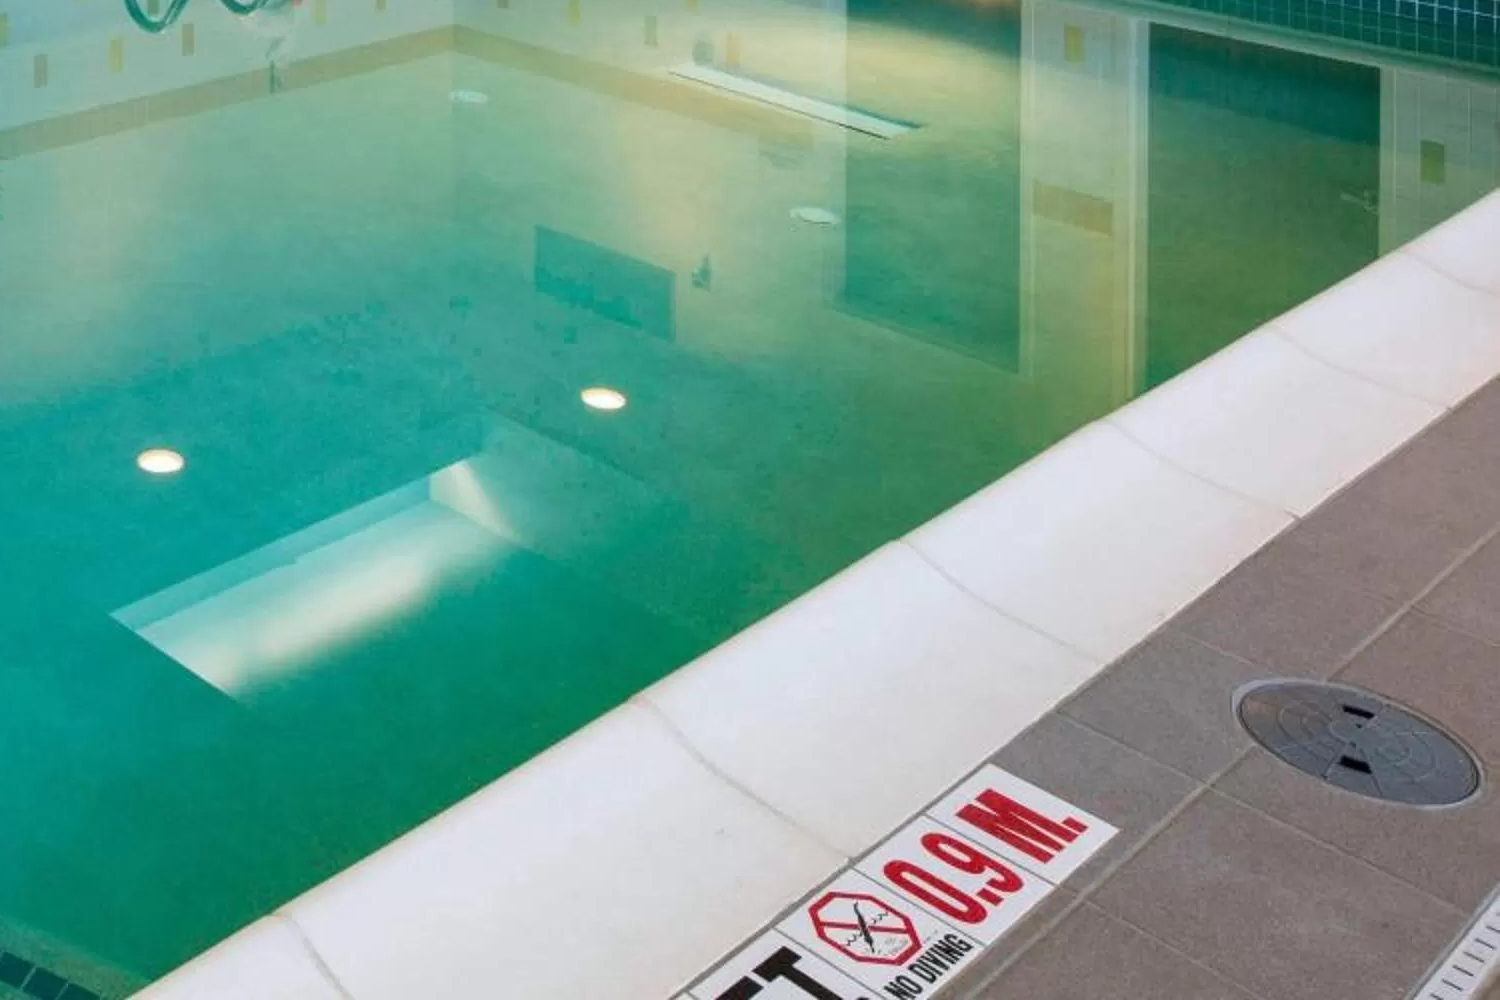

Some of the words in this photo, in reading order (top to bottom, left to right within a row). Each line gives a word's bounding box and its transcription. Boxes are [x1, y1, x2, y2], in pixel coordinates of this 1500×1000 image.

[882, 832, 1025, 925] 0.9
[955, 788, 1089, 865] M.
[883, 974, 924, 1000] NO
[907, 933, 974, 984] DIVING
